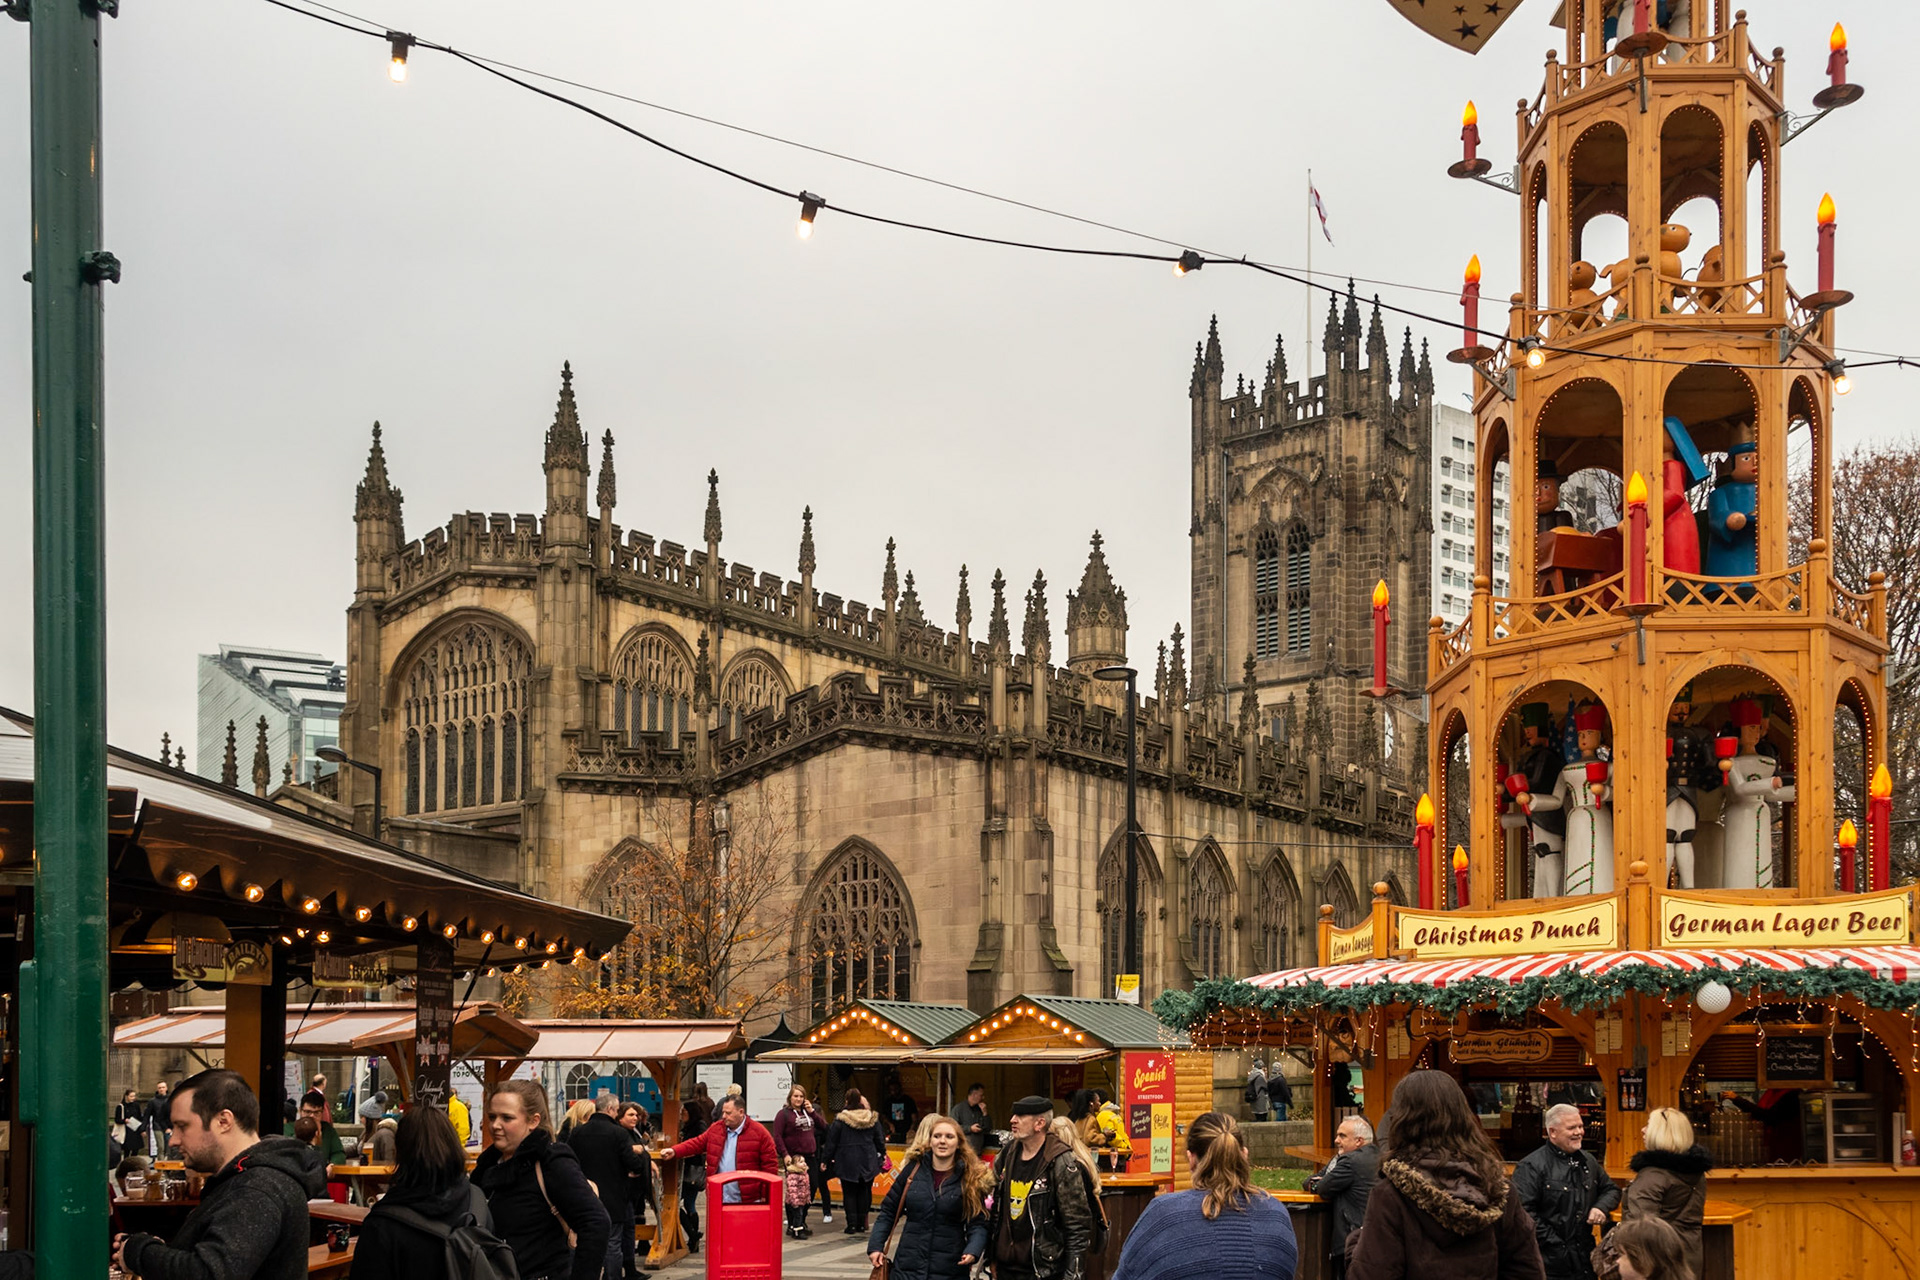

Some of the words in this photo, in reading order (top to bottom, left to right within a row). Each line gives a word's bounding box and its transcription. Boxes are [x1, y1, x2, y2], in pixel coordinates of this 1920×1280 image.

[1413, 924, 1524, 947] Christmas
[1530, 916, 1601, 941] Punch
[1669, 913, 1766, 938] German
[1772, 912, 1840, 937] Lager
[1847, 911, 1902, 934] Beer
[227, 942, 268, 968] BAILEYS
[1134, 1065, 1167, 1089] Spanish
